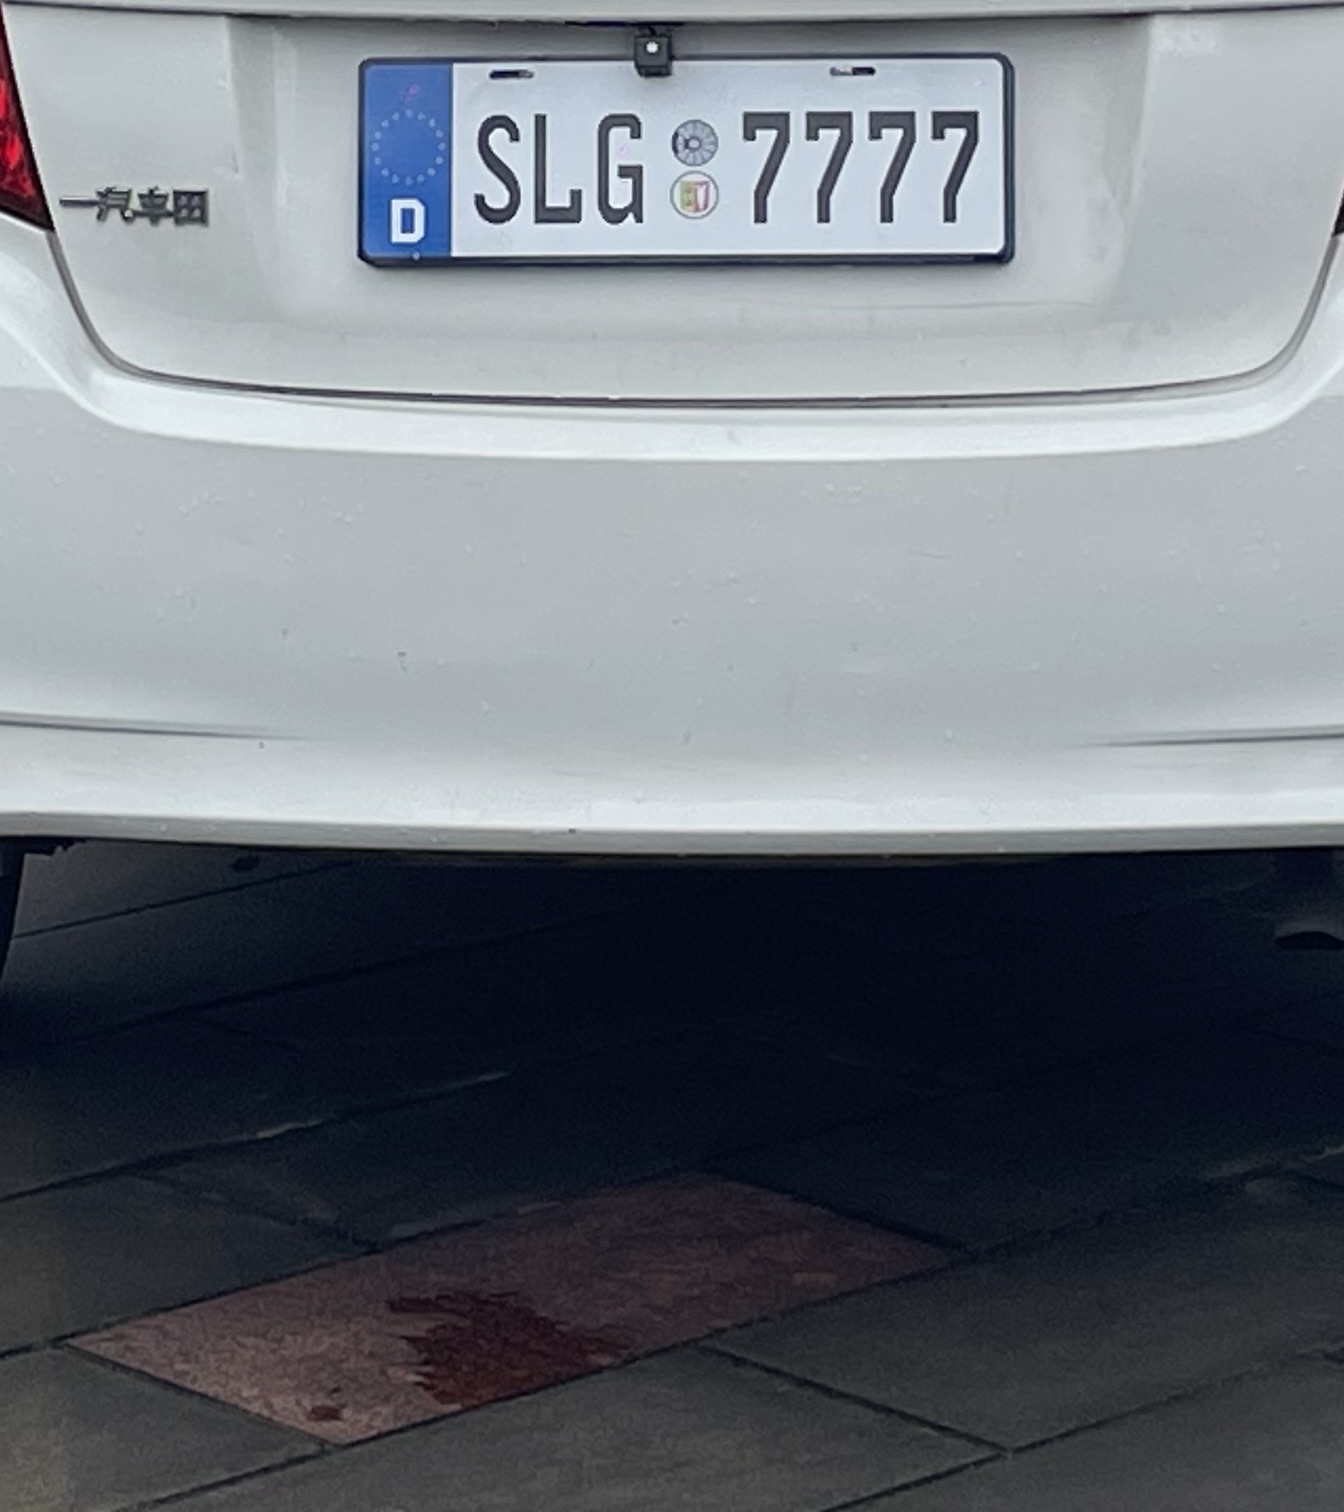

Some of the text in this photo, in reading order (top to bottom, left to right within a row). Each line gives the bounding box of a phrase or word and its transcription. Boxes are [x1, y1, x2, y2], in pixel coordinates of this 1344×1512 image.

[473, 111, 980, 225] SLG 7777
[390, 199, 425, 244] D
